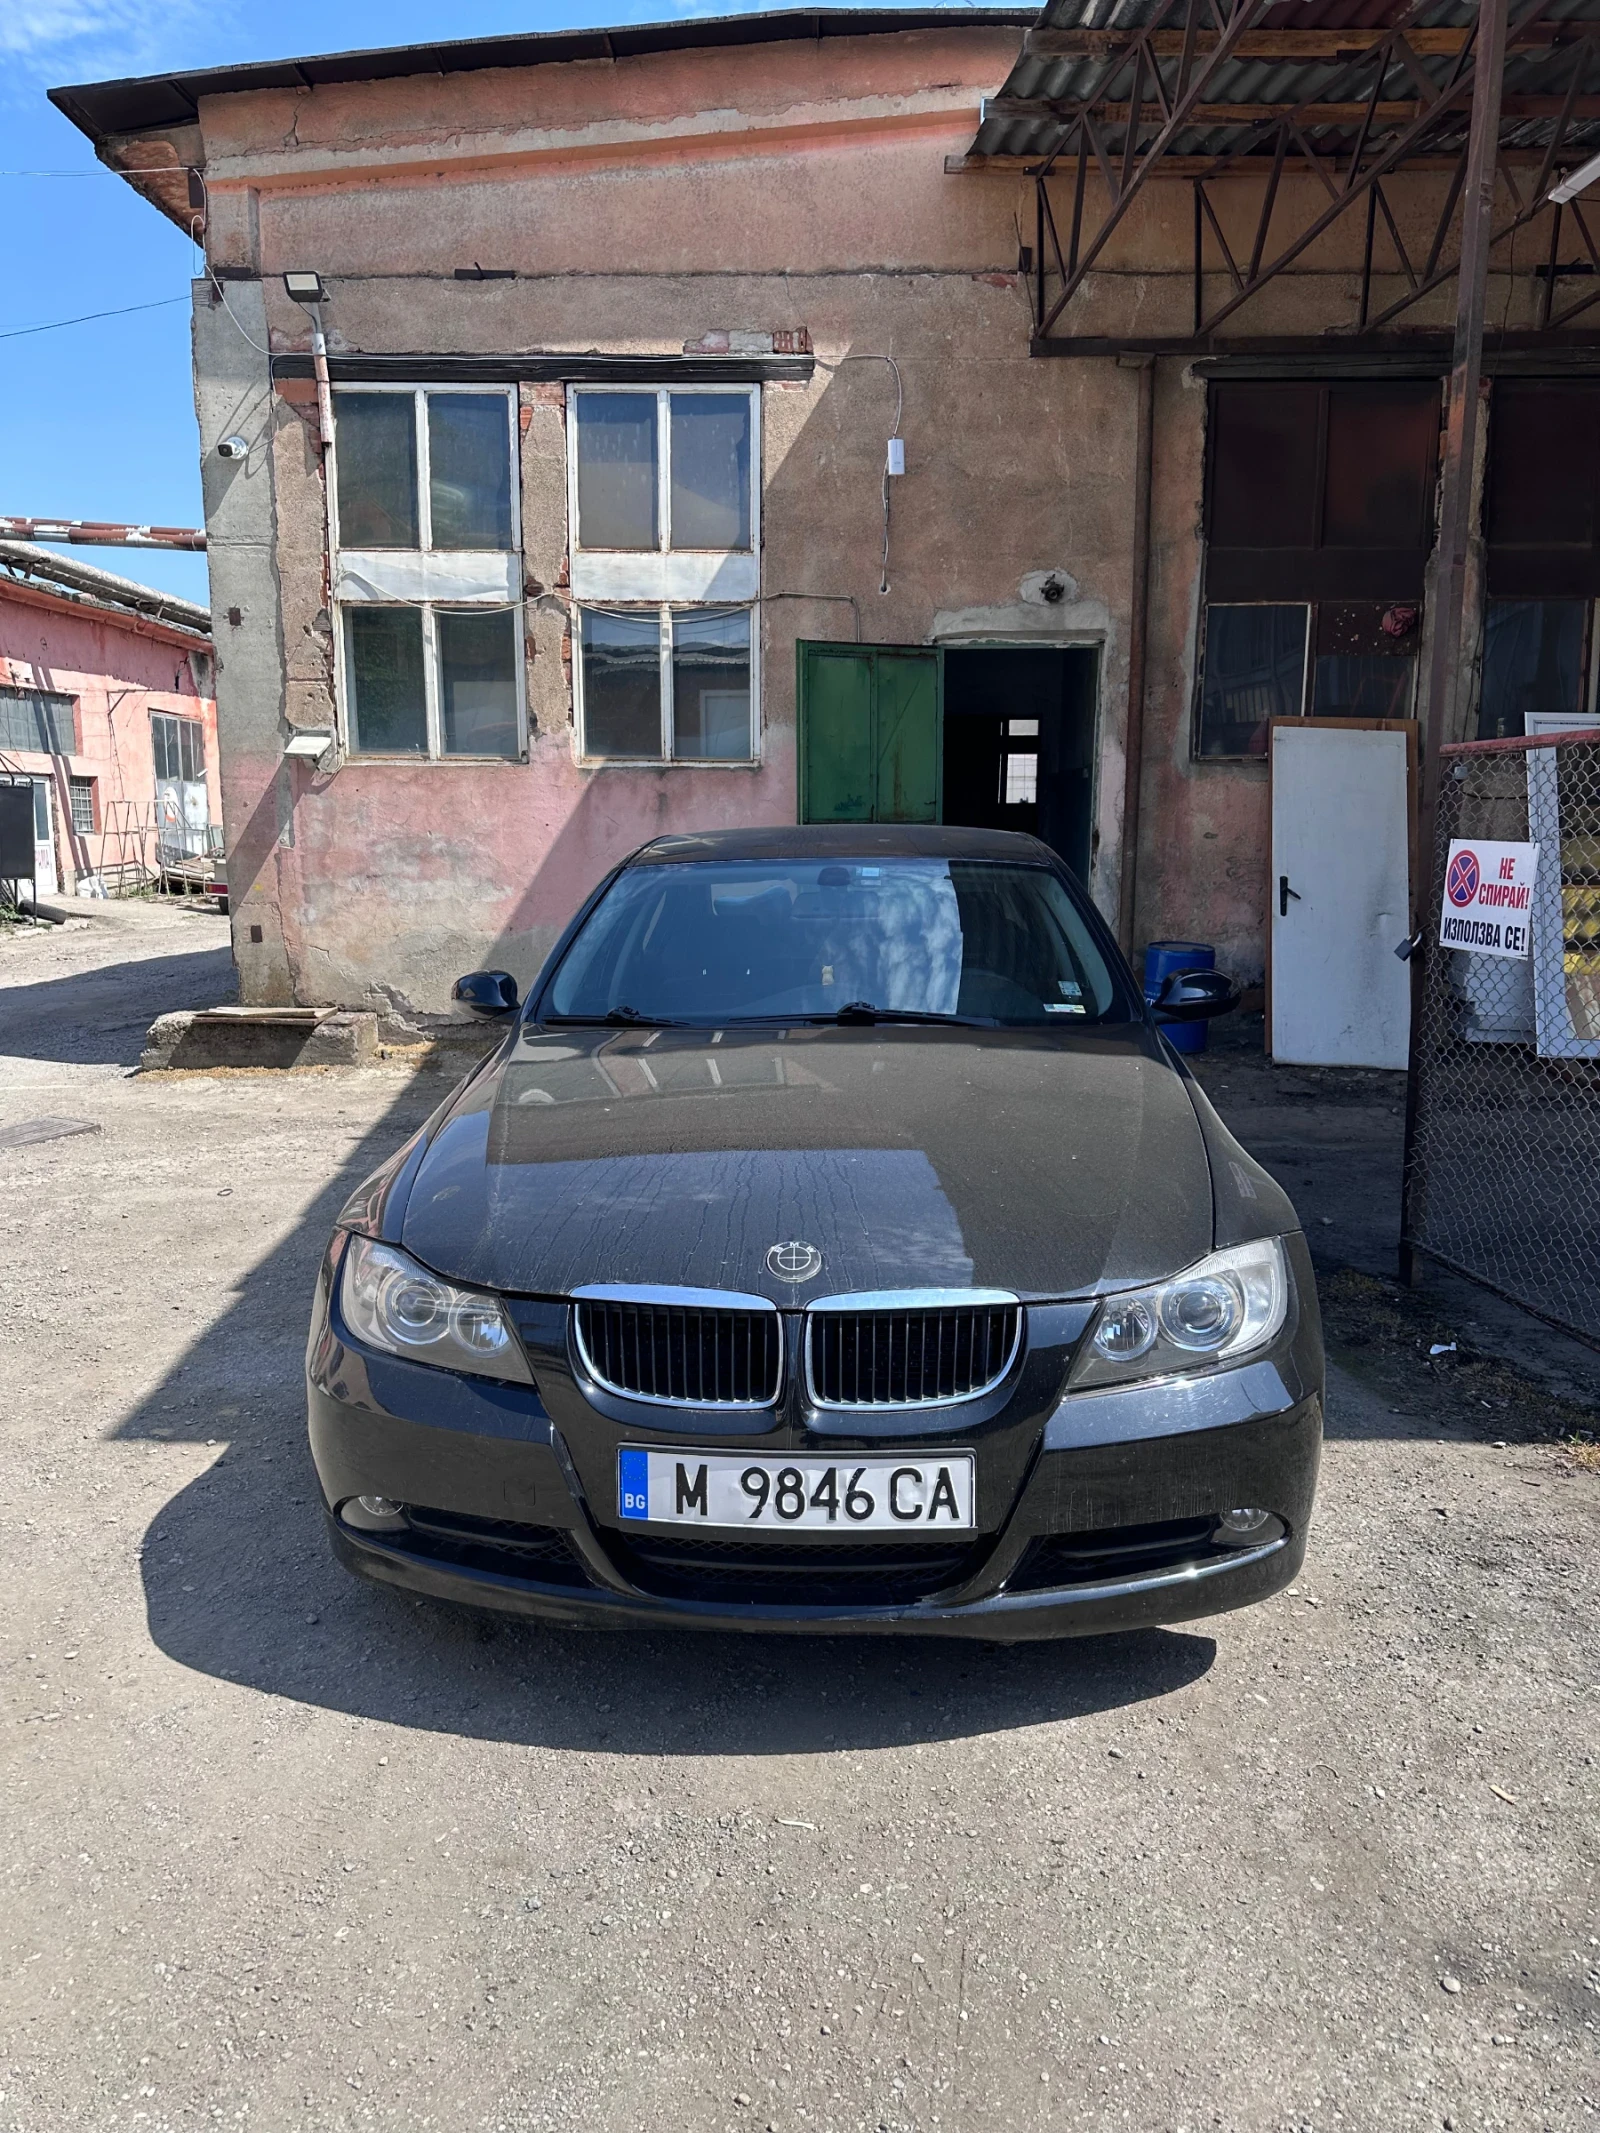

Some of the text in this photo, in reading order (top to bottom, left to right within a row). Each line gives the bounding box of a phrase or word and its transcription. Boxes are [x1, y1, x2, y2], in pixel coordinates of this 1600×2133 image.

[1499, 857, 1516, 880] НЕ
[1478, 882, 1530, 910] СПИРАЙ!
[1443, 917, 1526, 952] ИЗПОЛЗВА СЕ!
[624, 1492, 646, 1510] BG
[675, 1462, 961, 1521] M 9846 CA
